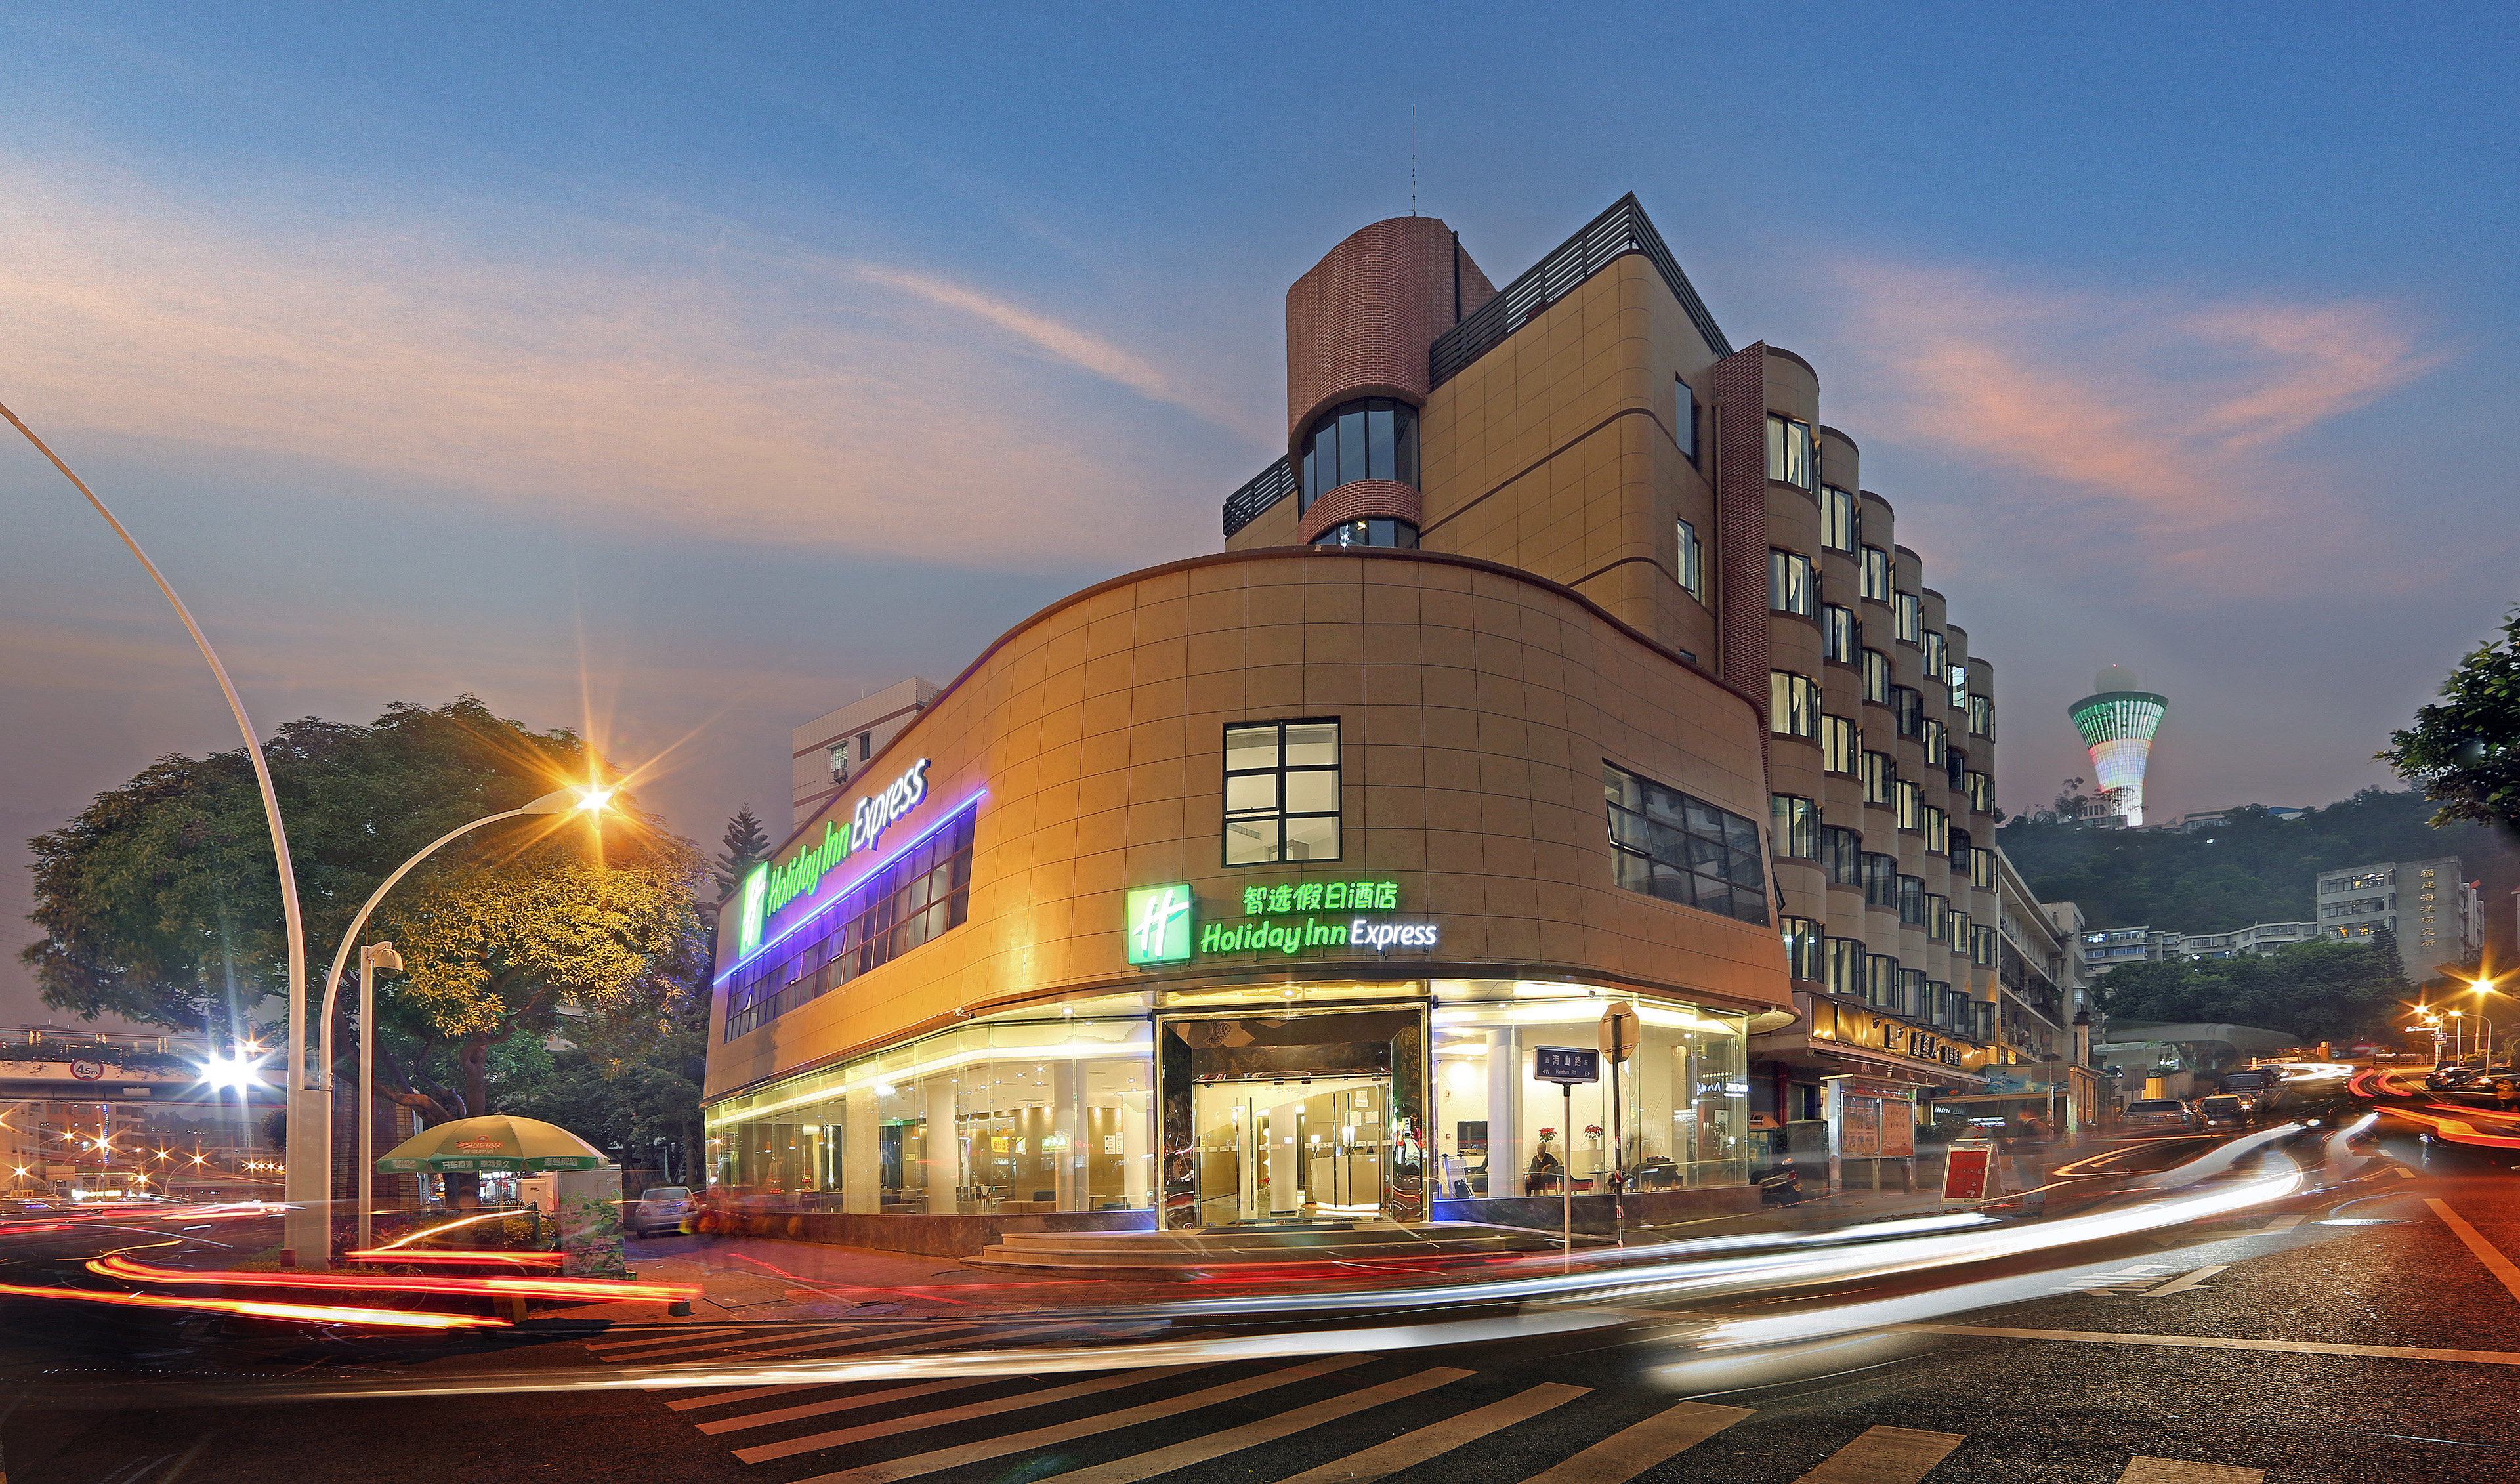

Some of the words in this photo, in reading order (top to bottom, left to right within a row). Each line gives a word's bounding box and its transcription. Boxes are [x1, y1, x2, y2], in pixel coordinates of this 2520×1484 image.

[766, 845, 823, 918] Holiday
[821, 820, 850, 875] Inn
[851, 757, 927, 852] Express
[1242, 881, 1398, 916] 智选假日酒店
[1200, 920, 1302, 954] Holiday
[1303, 917, 1347, 947] Inn
[1349, 919, 1437, 950] Express
[1553, 1054, 1582, 1067] 海山路
